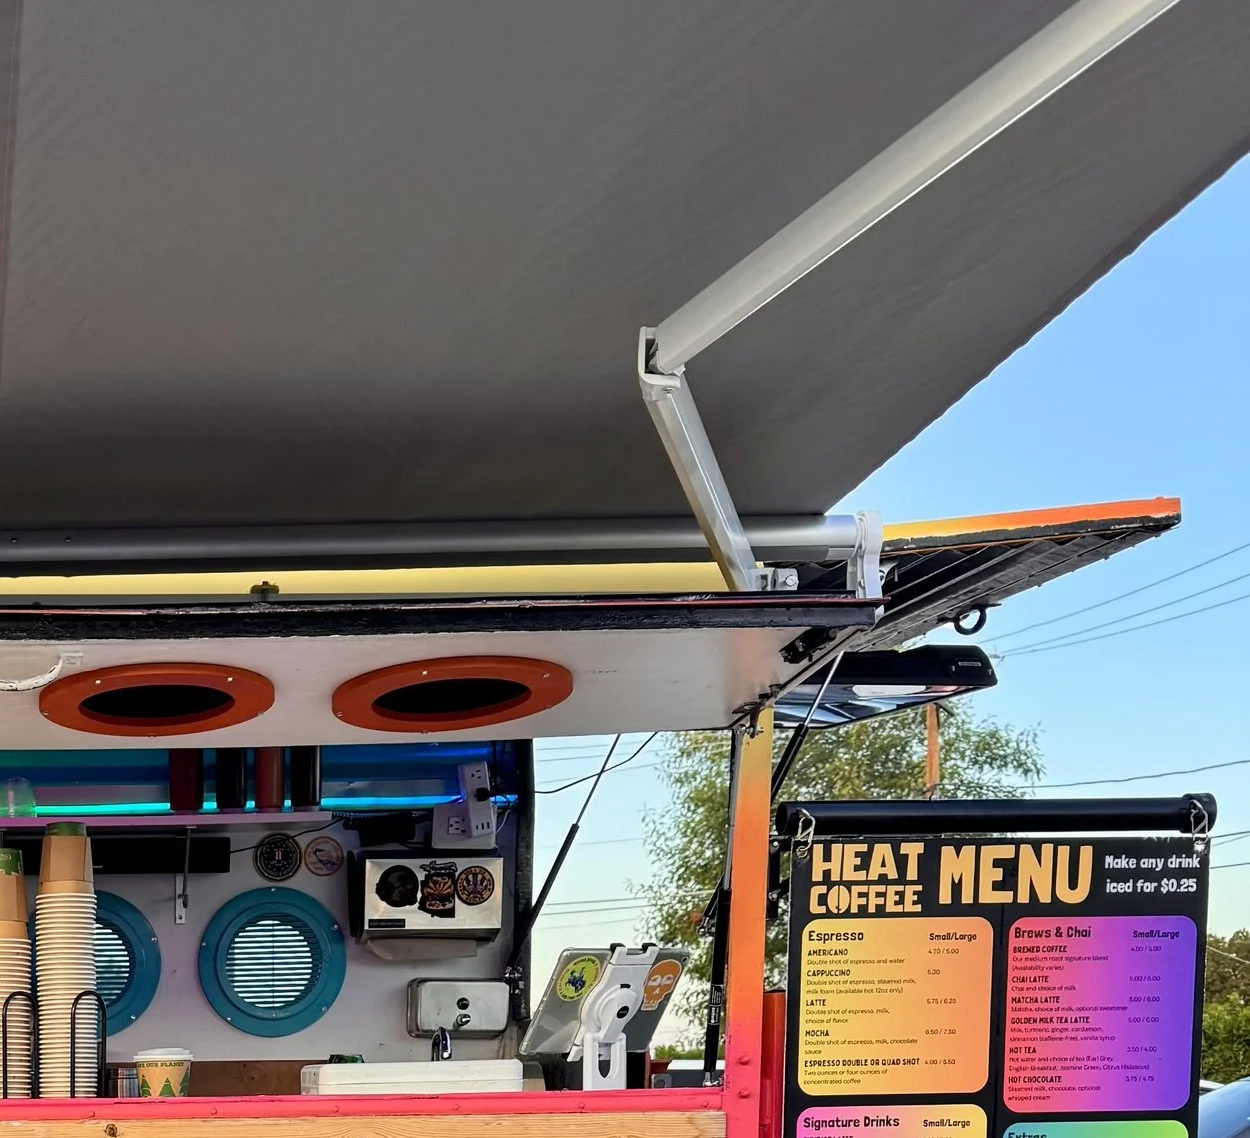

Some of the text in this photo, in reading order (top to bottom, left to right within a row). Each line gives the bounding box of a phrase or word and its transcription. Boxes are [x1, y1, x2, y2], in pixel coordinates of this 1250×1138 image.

[1105, 855, 1200, 871] Make any drink
[812, 842, 1093, 904] HEAT MENU
[1106, 878, 1197, 894] iced for $0.25
[810, 885, 922, 914] COFFEE
[808, 931, 977, 943] Espresso Small/Large
[1015, 926, 1179, 940] Brews & Chai Small/Large
[807, 969, 850, 977] CAPPUCCINO
[805, 1059, 840, 1067] ESPRESSO
[882, 1058, 900, 1066] QUAD
[803, 1116, 970, 1130] Signature Drinks Small/Large
